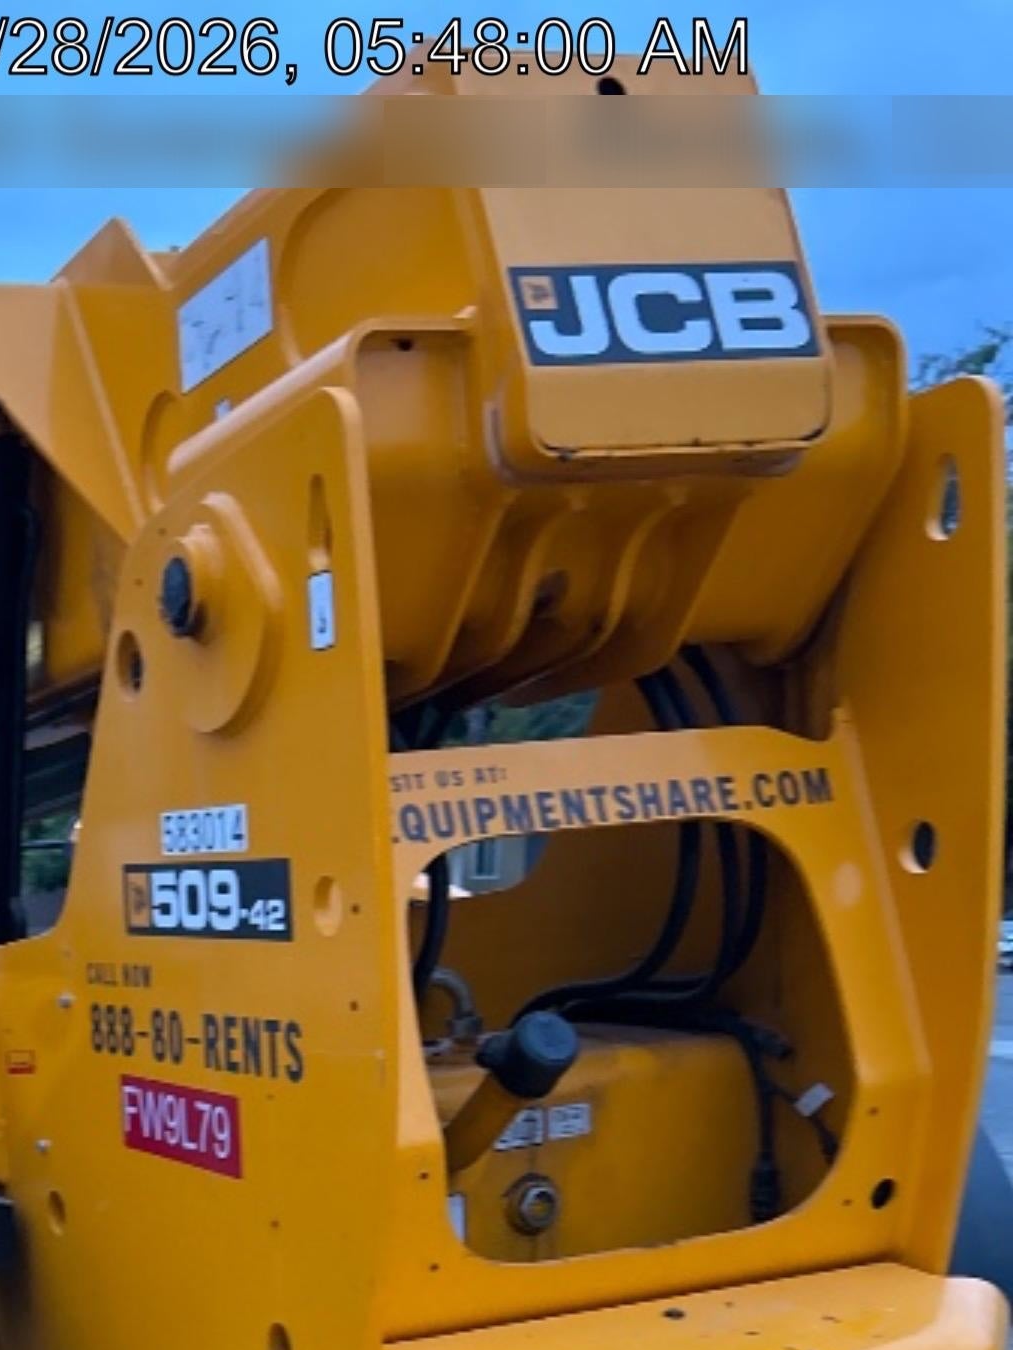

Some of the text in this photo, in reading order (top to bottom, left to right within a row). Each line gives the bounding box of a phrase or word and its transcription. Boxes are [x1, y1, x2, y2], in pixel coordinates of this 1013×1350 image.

[529, 271, 811, 356] JCB
[391, 768, 834, 844] QUIPMENTSHARE.COM
[434, 769, 463, 789] US
[163, 810, 245, 851] 583014
[91, 1002, 305, 1083] 888-80-RENTS
[122, 1084, 231, 1159] FW9L79
